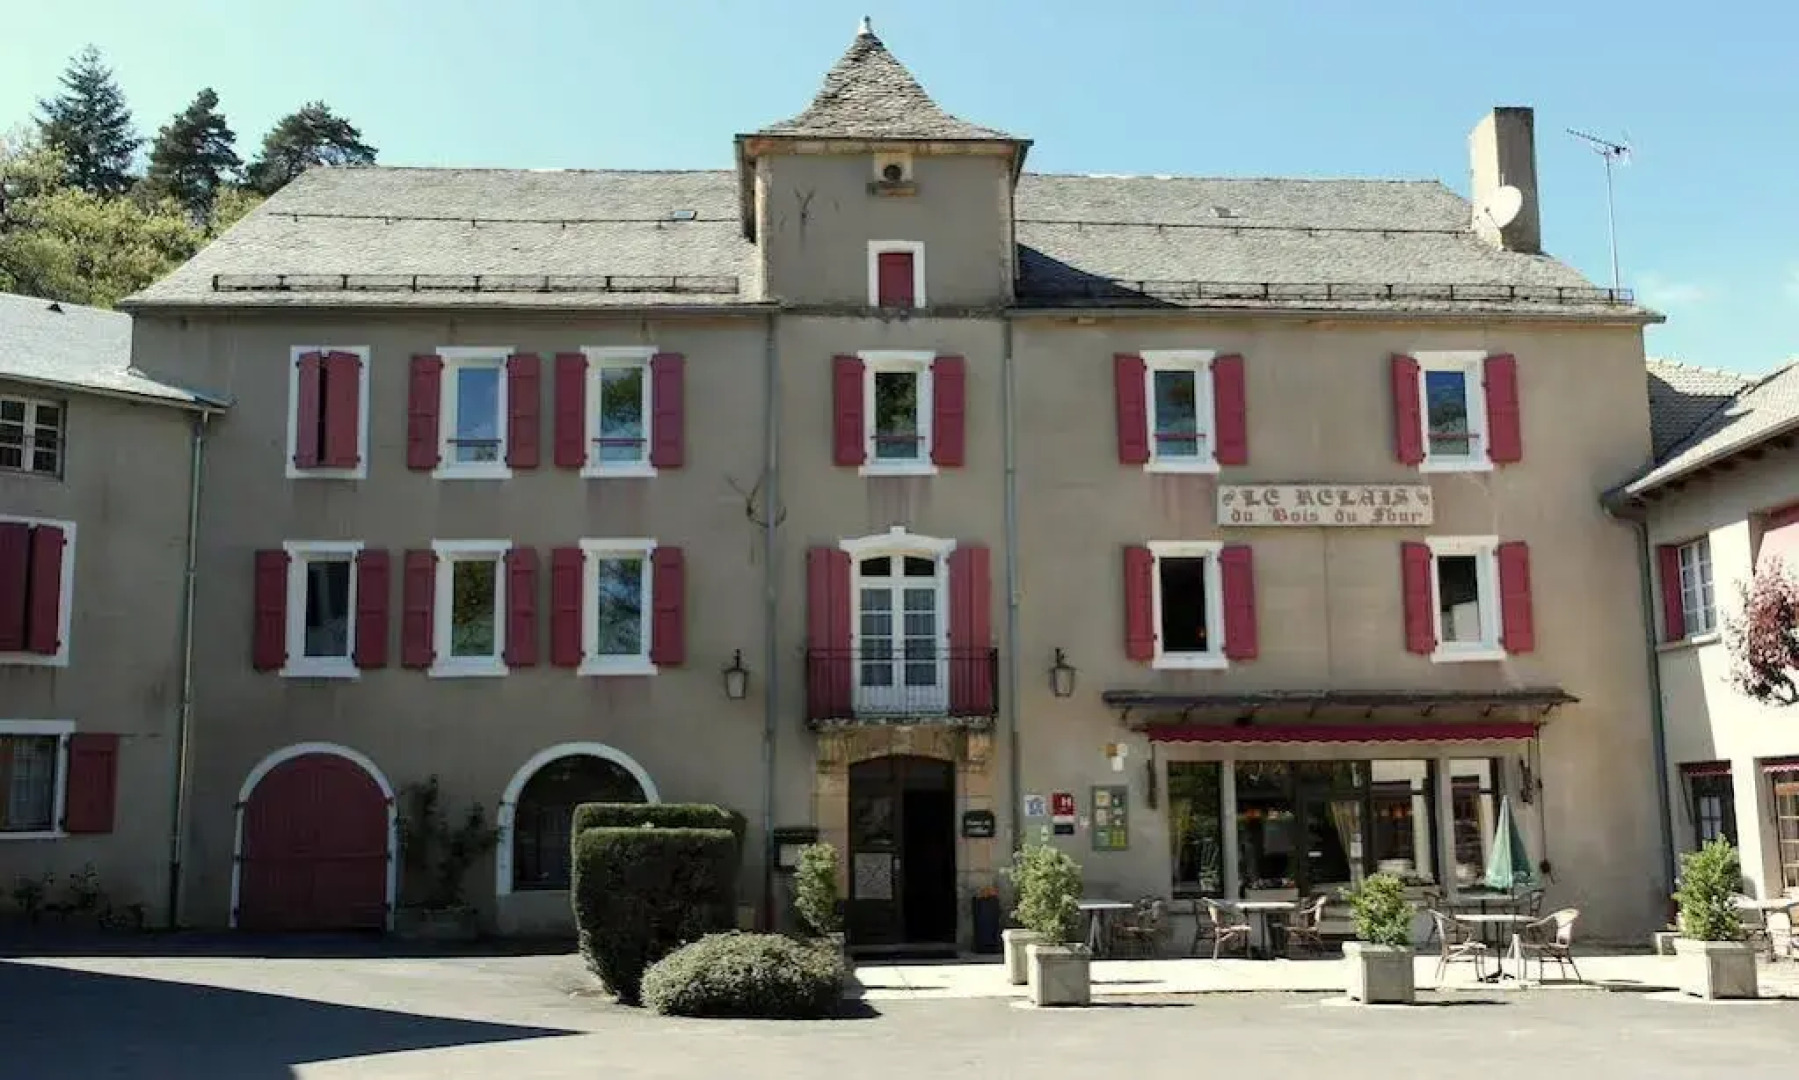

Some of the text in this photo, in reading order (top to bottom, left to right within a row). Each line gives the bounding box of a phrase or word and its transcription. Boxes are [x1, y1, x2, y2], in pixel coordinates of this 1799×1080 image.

[1242, 487, 1410, 506] LE RELAIS
[1231, 507, 1253, 522] du
[1271, 507, 1319, 522] Bois
[1335, 508, 1357, 522] du
